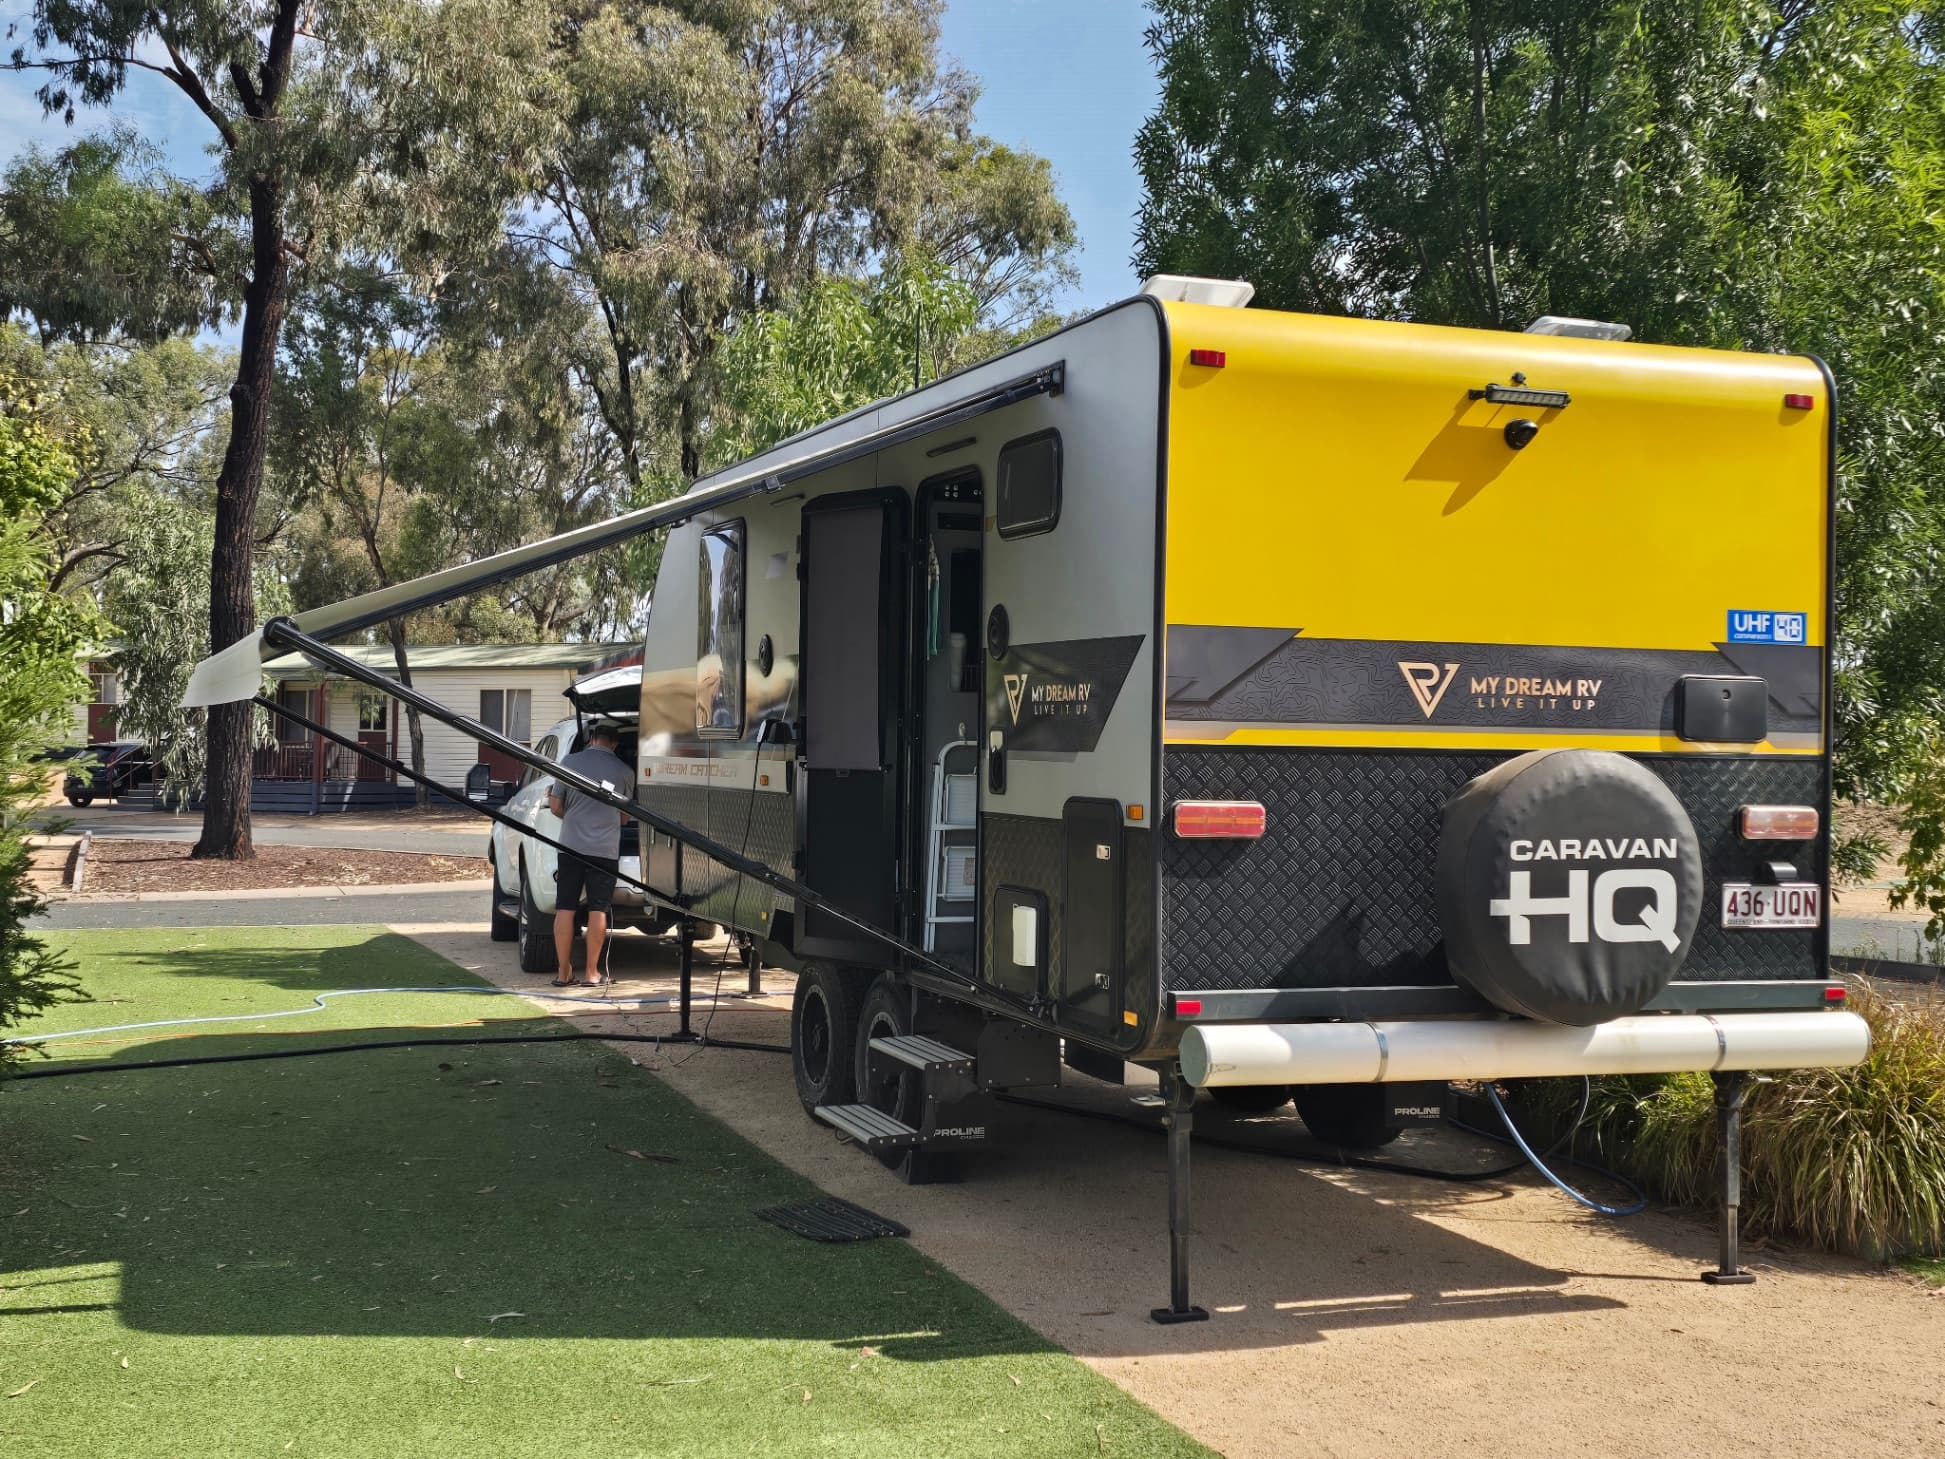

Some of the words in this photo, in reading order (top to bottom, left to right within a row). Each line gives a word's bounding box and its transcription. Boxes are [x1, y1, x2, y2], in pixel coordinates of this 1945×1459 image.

[1734, 613, 1771, 632] UHF
[1031, 684, 1044, 702] MY
[1046, 683, 1076, 702] DREAM
[1078, 683, 1091, 701] RV
[1471, 677, 1499, 695] MY
[1505, 678, 1572, 697] DREAM
[1577, 679, 1602, 697] RV
[1034, 704, 1055, 716] LIVE
[1061, 704, 1070, 715] IT
[1076, 704, 1088, 716] UP
[1477, 697, 1524, 709] LIVE
[1540, 698, 1557, 710] IT
[1572, 699, 1596, 711] UP
[1510, 838, 1678, 861] CARAVAN
[1490, 868, 1681, 955] HQ
[1727, 891, 1764, 916] 436
[1774, 891, 1817, 917] UQN
[1394, 1107, 1440, 1115] PROLINE
[933, 1127, 985, 1136] PROLINE
